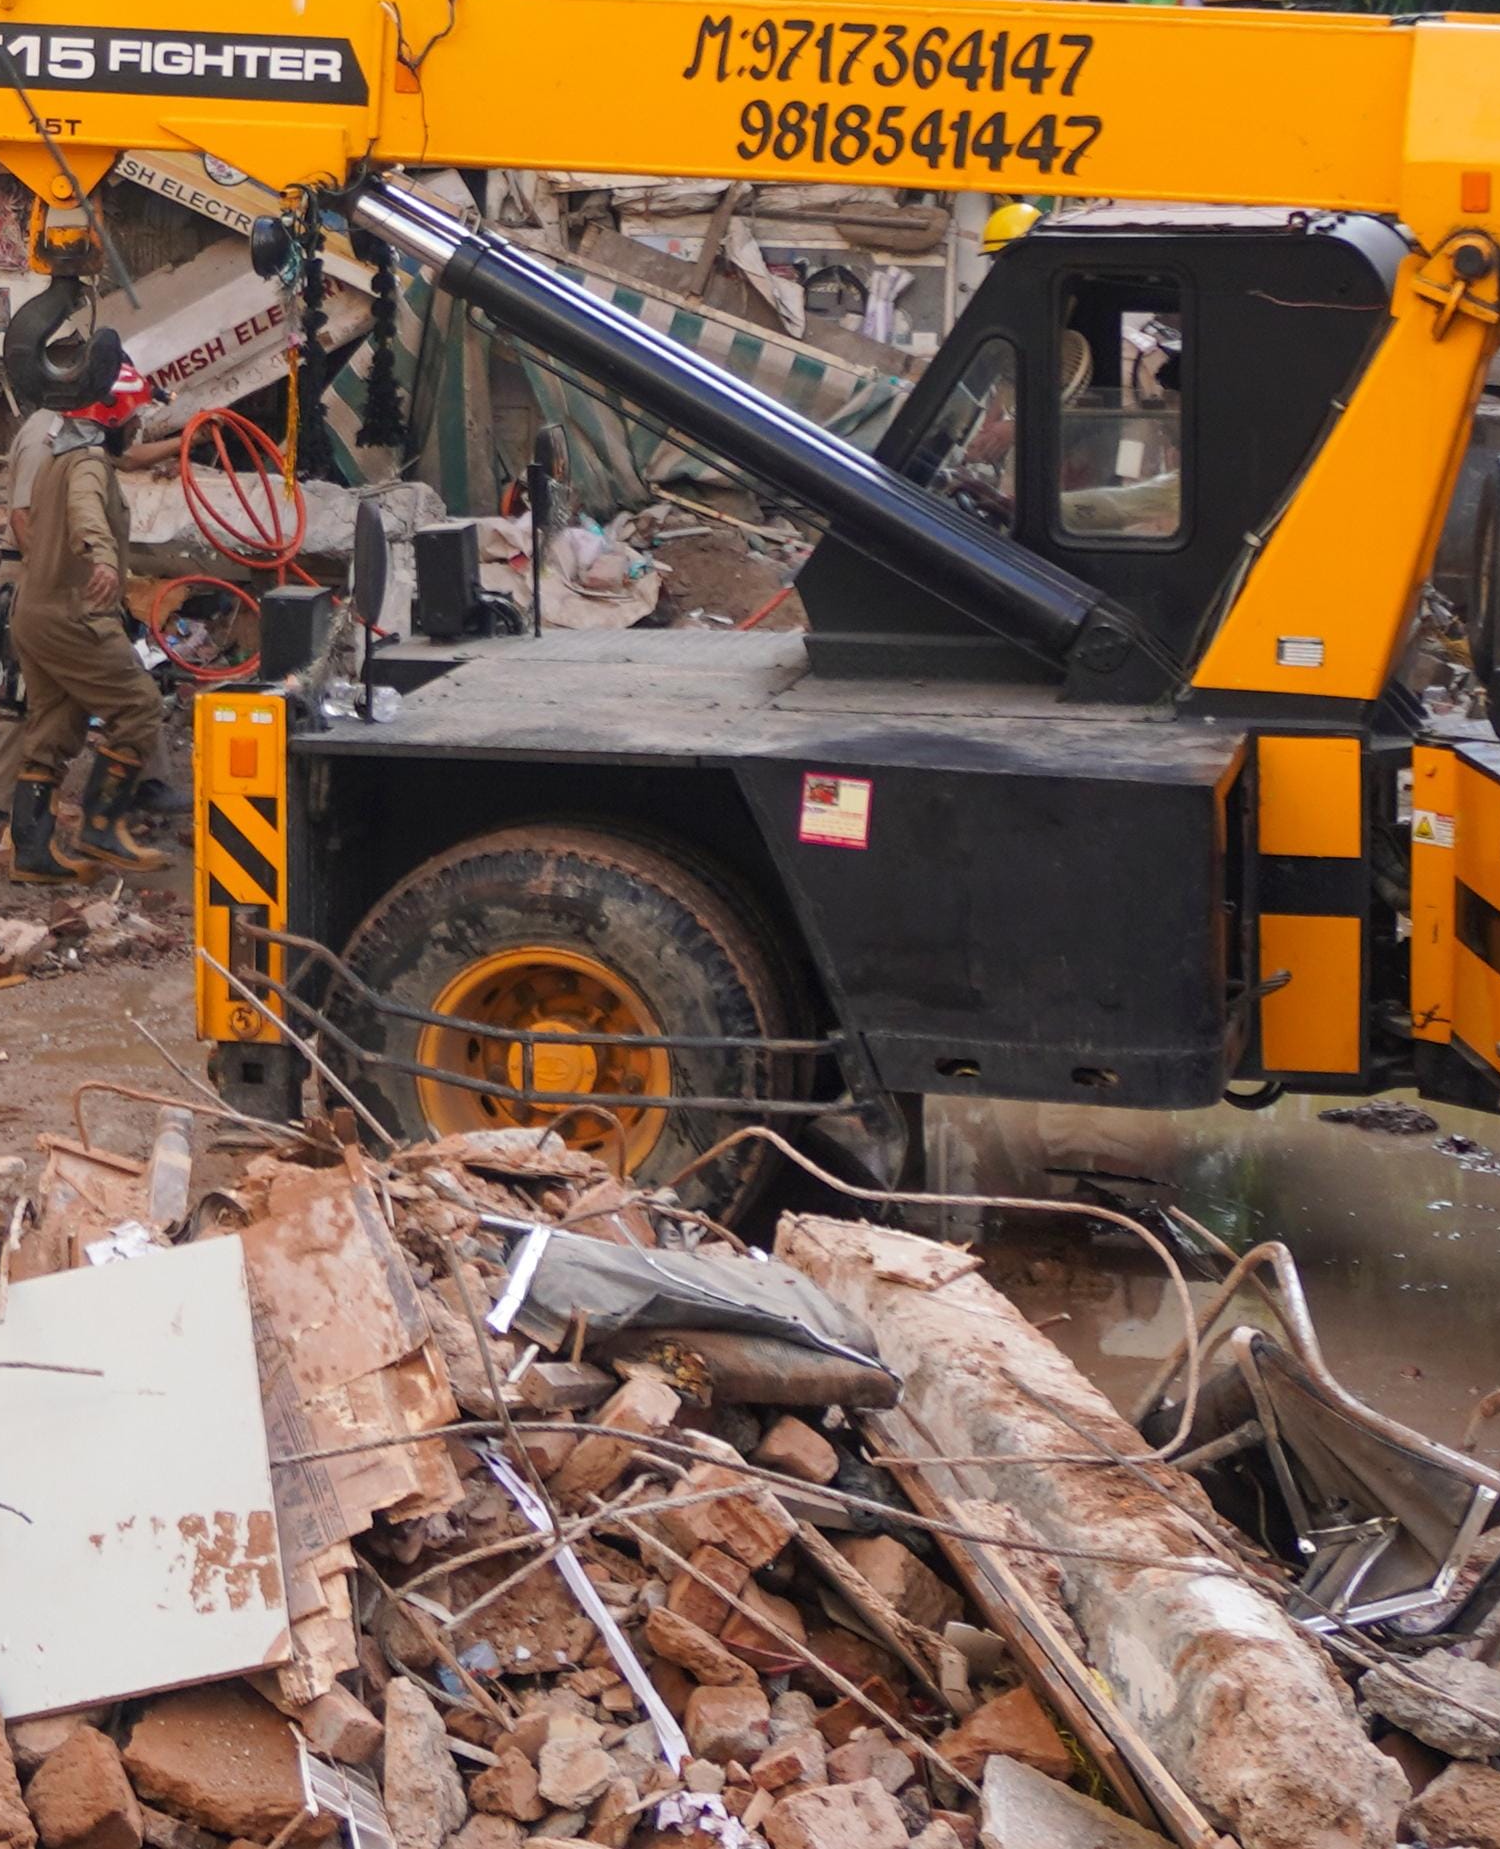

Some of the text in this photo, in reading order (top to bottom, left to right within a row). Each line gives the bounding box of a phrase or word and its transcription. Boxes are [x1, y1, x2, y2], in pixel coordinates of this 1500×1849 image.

[107, 39, 343, 83] FIGHTER
[28, 118, 83, 137] 15T
[736, 98, 1103, 176] 9818541447
[160, 176, 254, 233] ELECTR
[146, 338, 226, 391] AMESH
